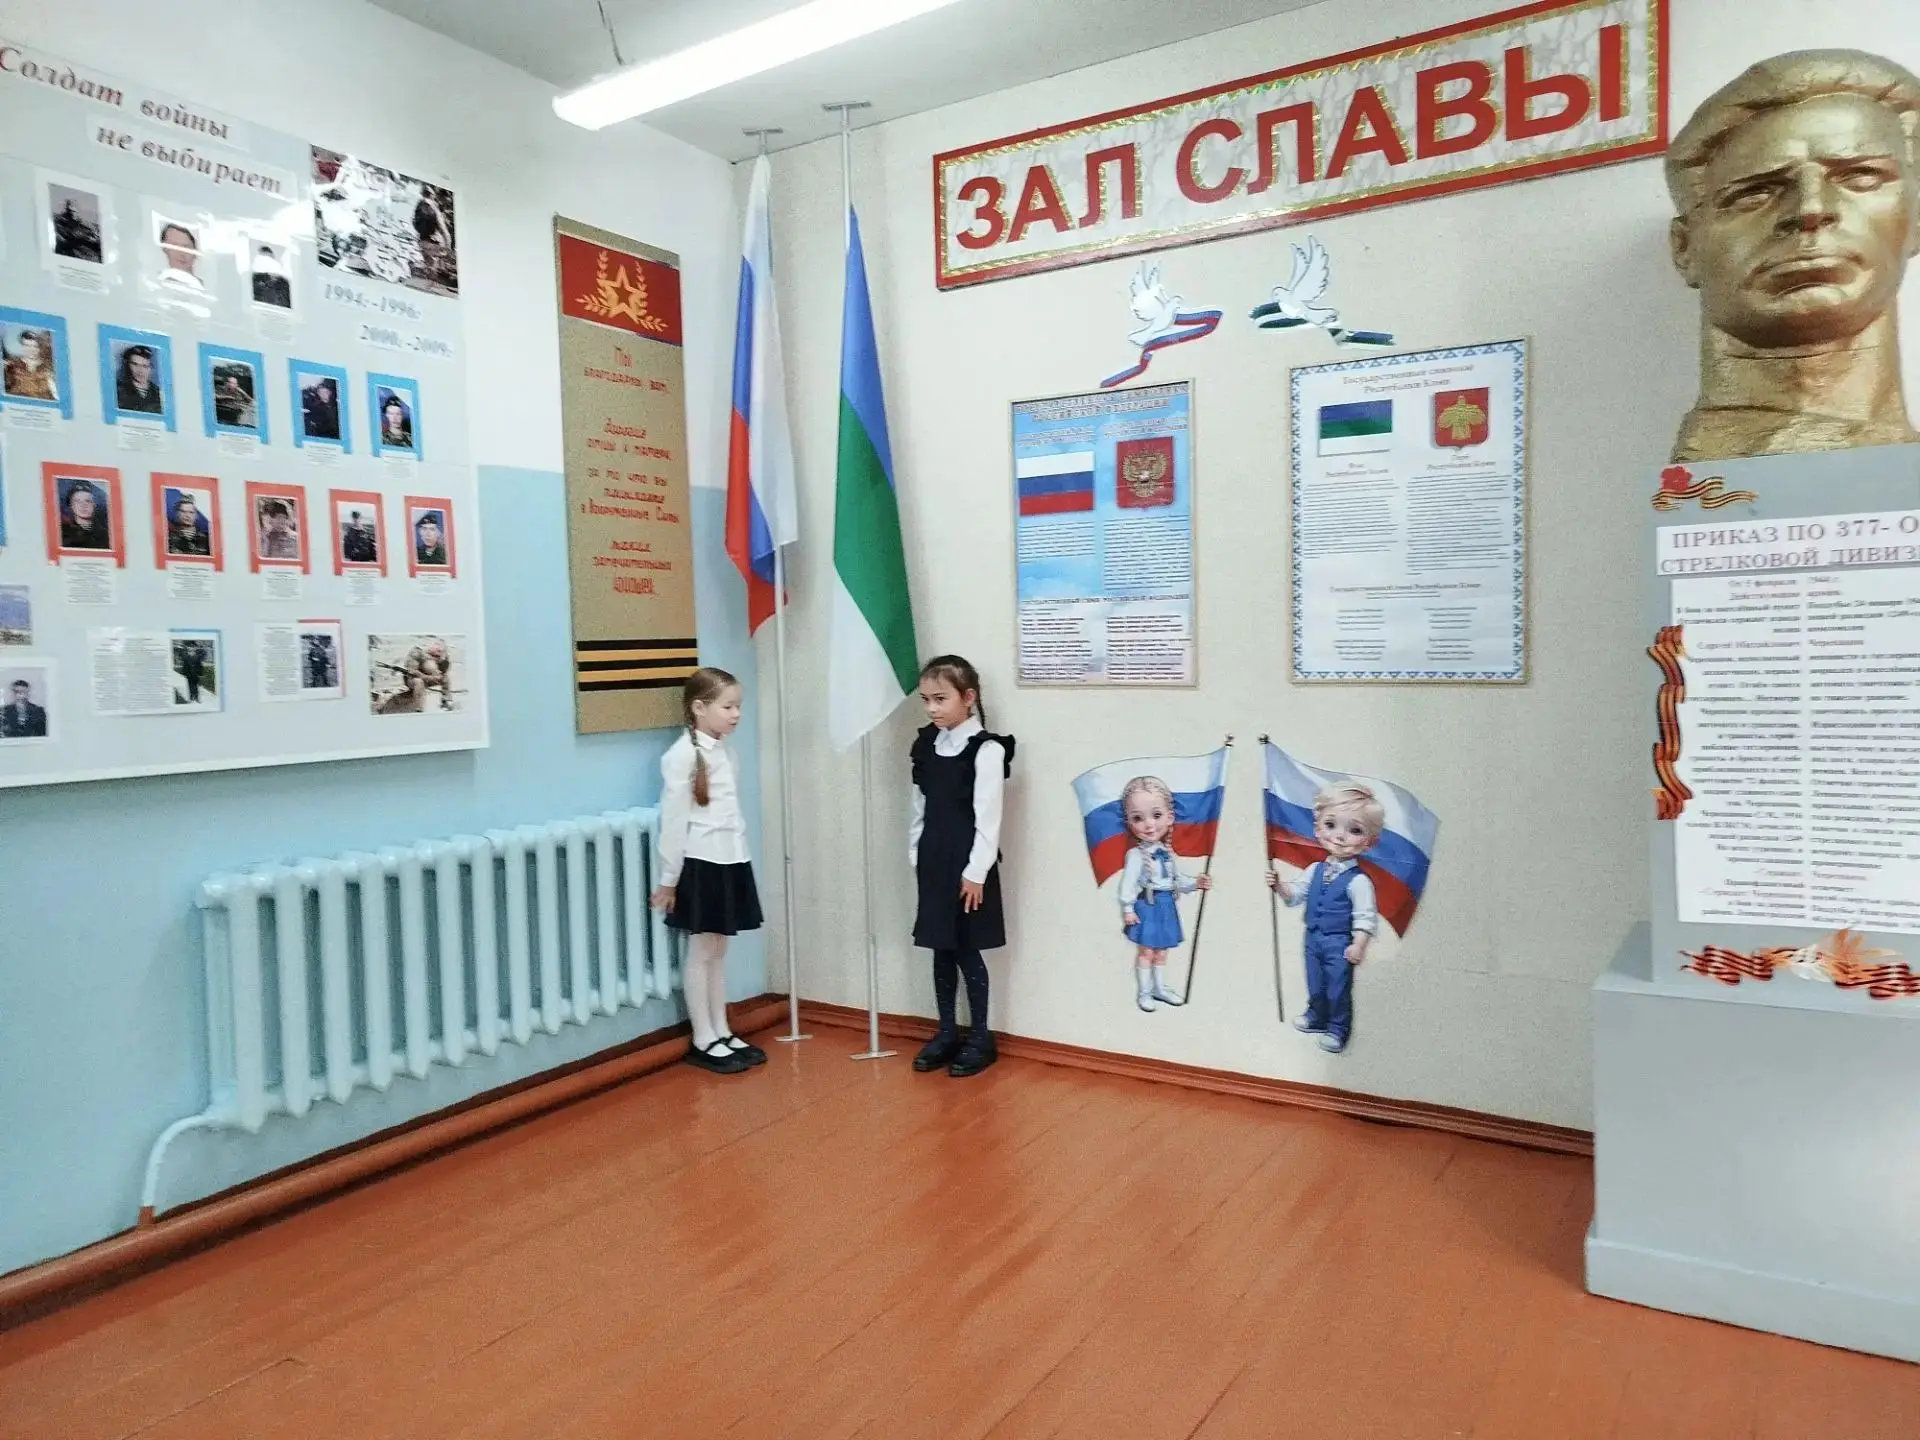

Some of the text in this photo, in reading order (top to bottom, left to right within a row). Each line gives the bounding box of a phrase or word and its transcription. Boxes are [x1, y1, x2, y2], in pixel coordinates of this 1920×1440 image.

[0, 46, 229, 140] Солдат войны
[96, 127, 281, 194] не выбирает
[956, 23, 1626, 250] ЗАЛ СЛАВЫ
[1660, 544, 1920, 574] СТРЕЛКОВОЙ ДИВИЗ
[1672, 526, 1779, 549] ПРИКАЗ
[1787, 518, 1825, 542] ПО
[1836, 518, 1890, 537] 377-
